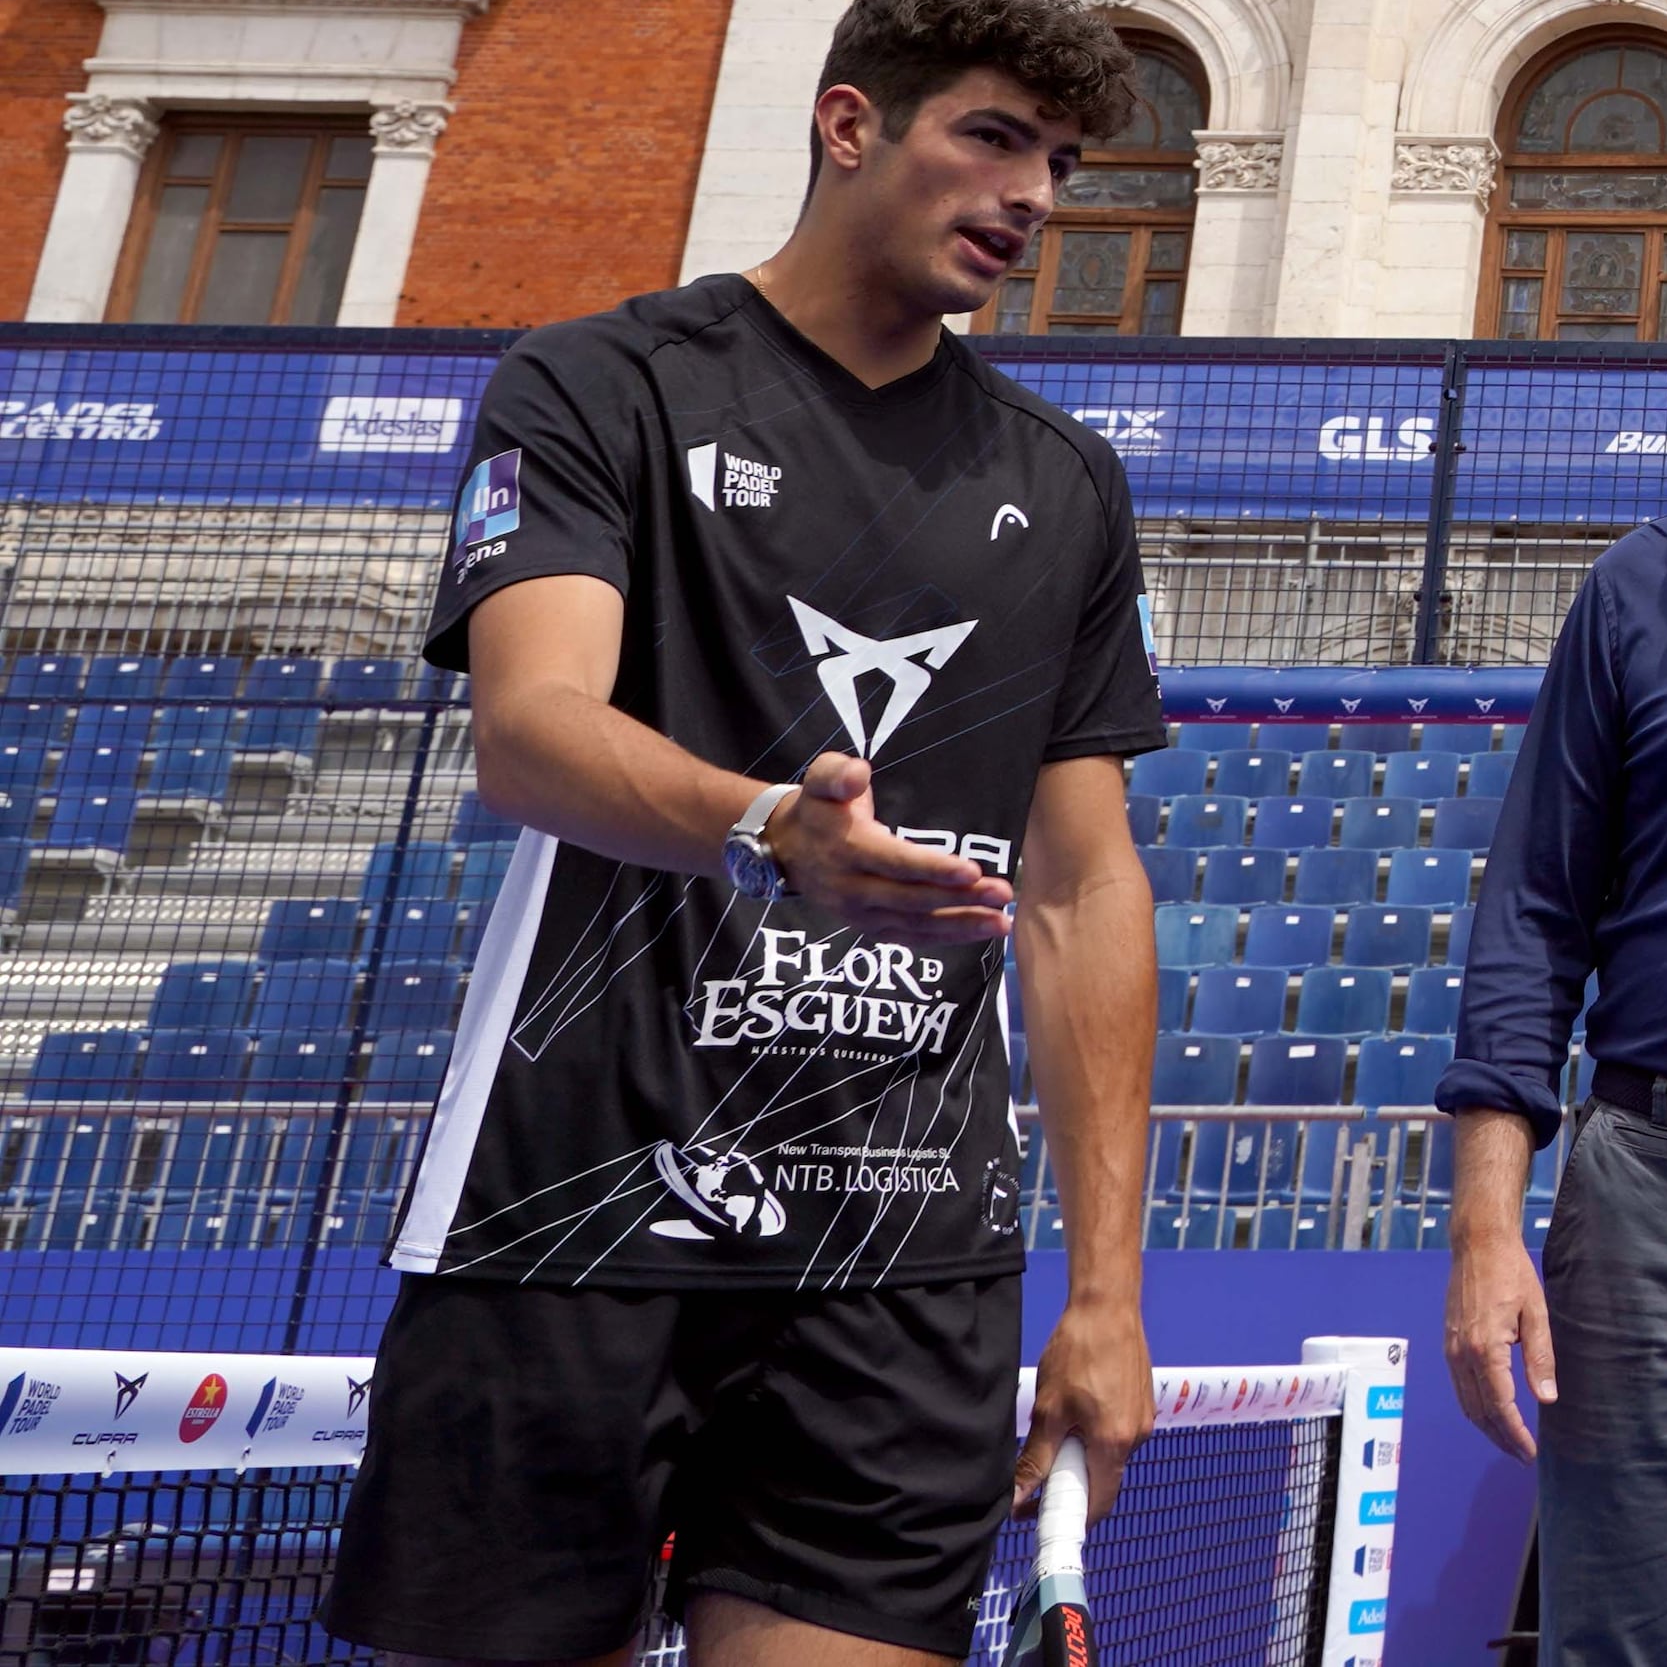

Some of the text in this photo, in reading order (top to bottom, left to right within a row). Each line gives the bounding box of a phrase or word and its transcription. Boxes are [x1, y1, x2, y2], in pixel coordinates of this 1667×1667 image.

[0, 421, 163, 441] UESTRO
[341, 410, 443, 436] Adeslas
[1318, 415, 1434, 461] GLS
[724, 452, 782, 480] WORLD
[724, 469, 779, 494] PADEL
[722, 487, 771, 507] TOUR
[457, 539, 507, 585] aena
[754, 926, 933, 1001] FLOR
[693, 979, 959, 1057] ESGUEVA
[833, 1048, 895, 1064] QUESEROS
[778, 1144, 808, 1155] New
[28, 1379, 62, 1400] WORLD
[278, 1383, 305, 1401] WORLD
[18, 1398, 52, 1416] PADEL
[270, 1400, 296, 1415] PADEL
[1375, 1393, 1404, 1411] Ades
[8, 1416, 42, 1435] TOUR
[262, 1415, 290, 1433] TOUR
[72, 1432, 139, 1445] CUPRA
[312, 1429, 366, 1442] CUPRA
[1368, 1498, 1396, 1516] Ades
[1358, 1607, 1386, 1625] Ades
